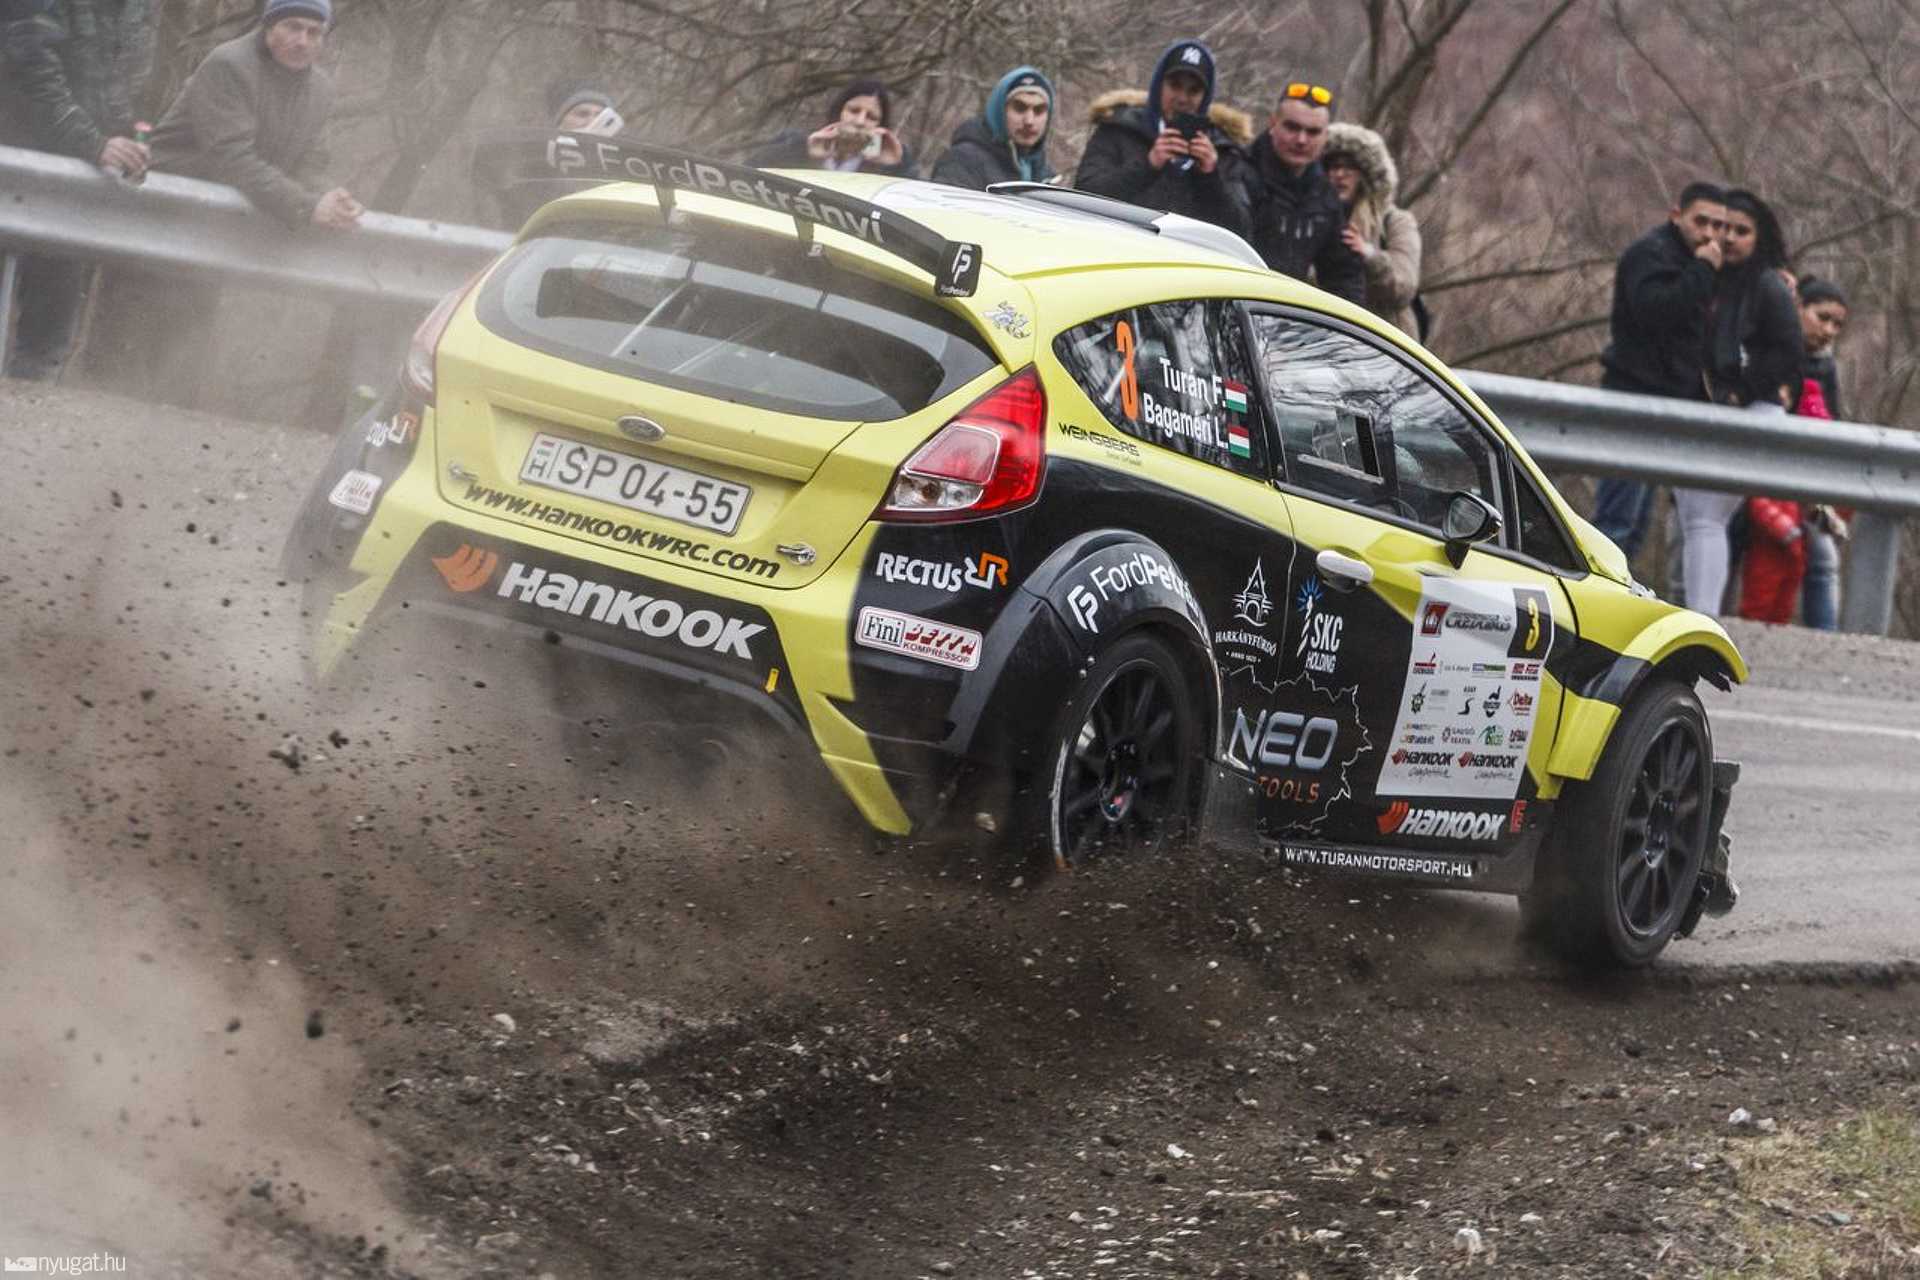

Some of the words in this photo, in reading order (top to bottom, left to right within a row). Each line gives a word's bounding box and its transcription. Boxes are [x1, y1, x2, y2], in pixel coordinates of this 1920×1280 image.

[598, 142, 885, 243] FordPetrányi
[1115, 320, 1139, 423] 3
[1159, 357, 1209, 400] Turán
[1212, 374, 1227, 408] F.
[1142, 392, 1212, 443] Bagaméri
[1215, 417, 1229, 449] L.
[876, 552, 963, 592] RECTUS
[865, 615, 902, 645] Fini
[1310, 612, 1344, 652] SKC
[1526, 597, 1540, 651] 3
[1305, 649, 1337, 673] HOLDING
[1227, 706, 1339, 774] NEO
